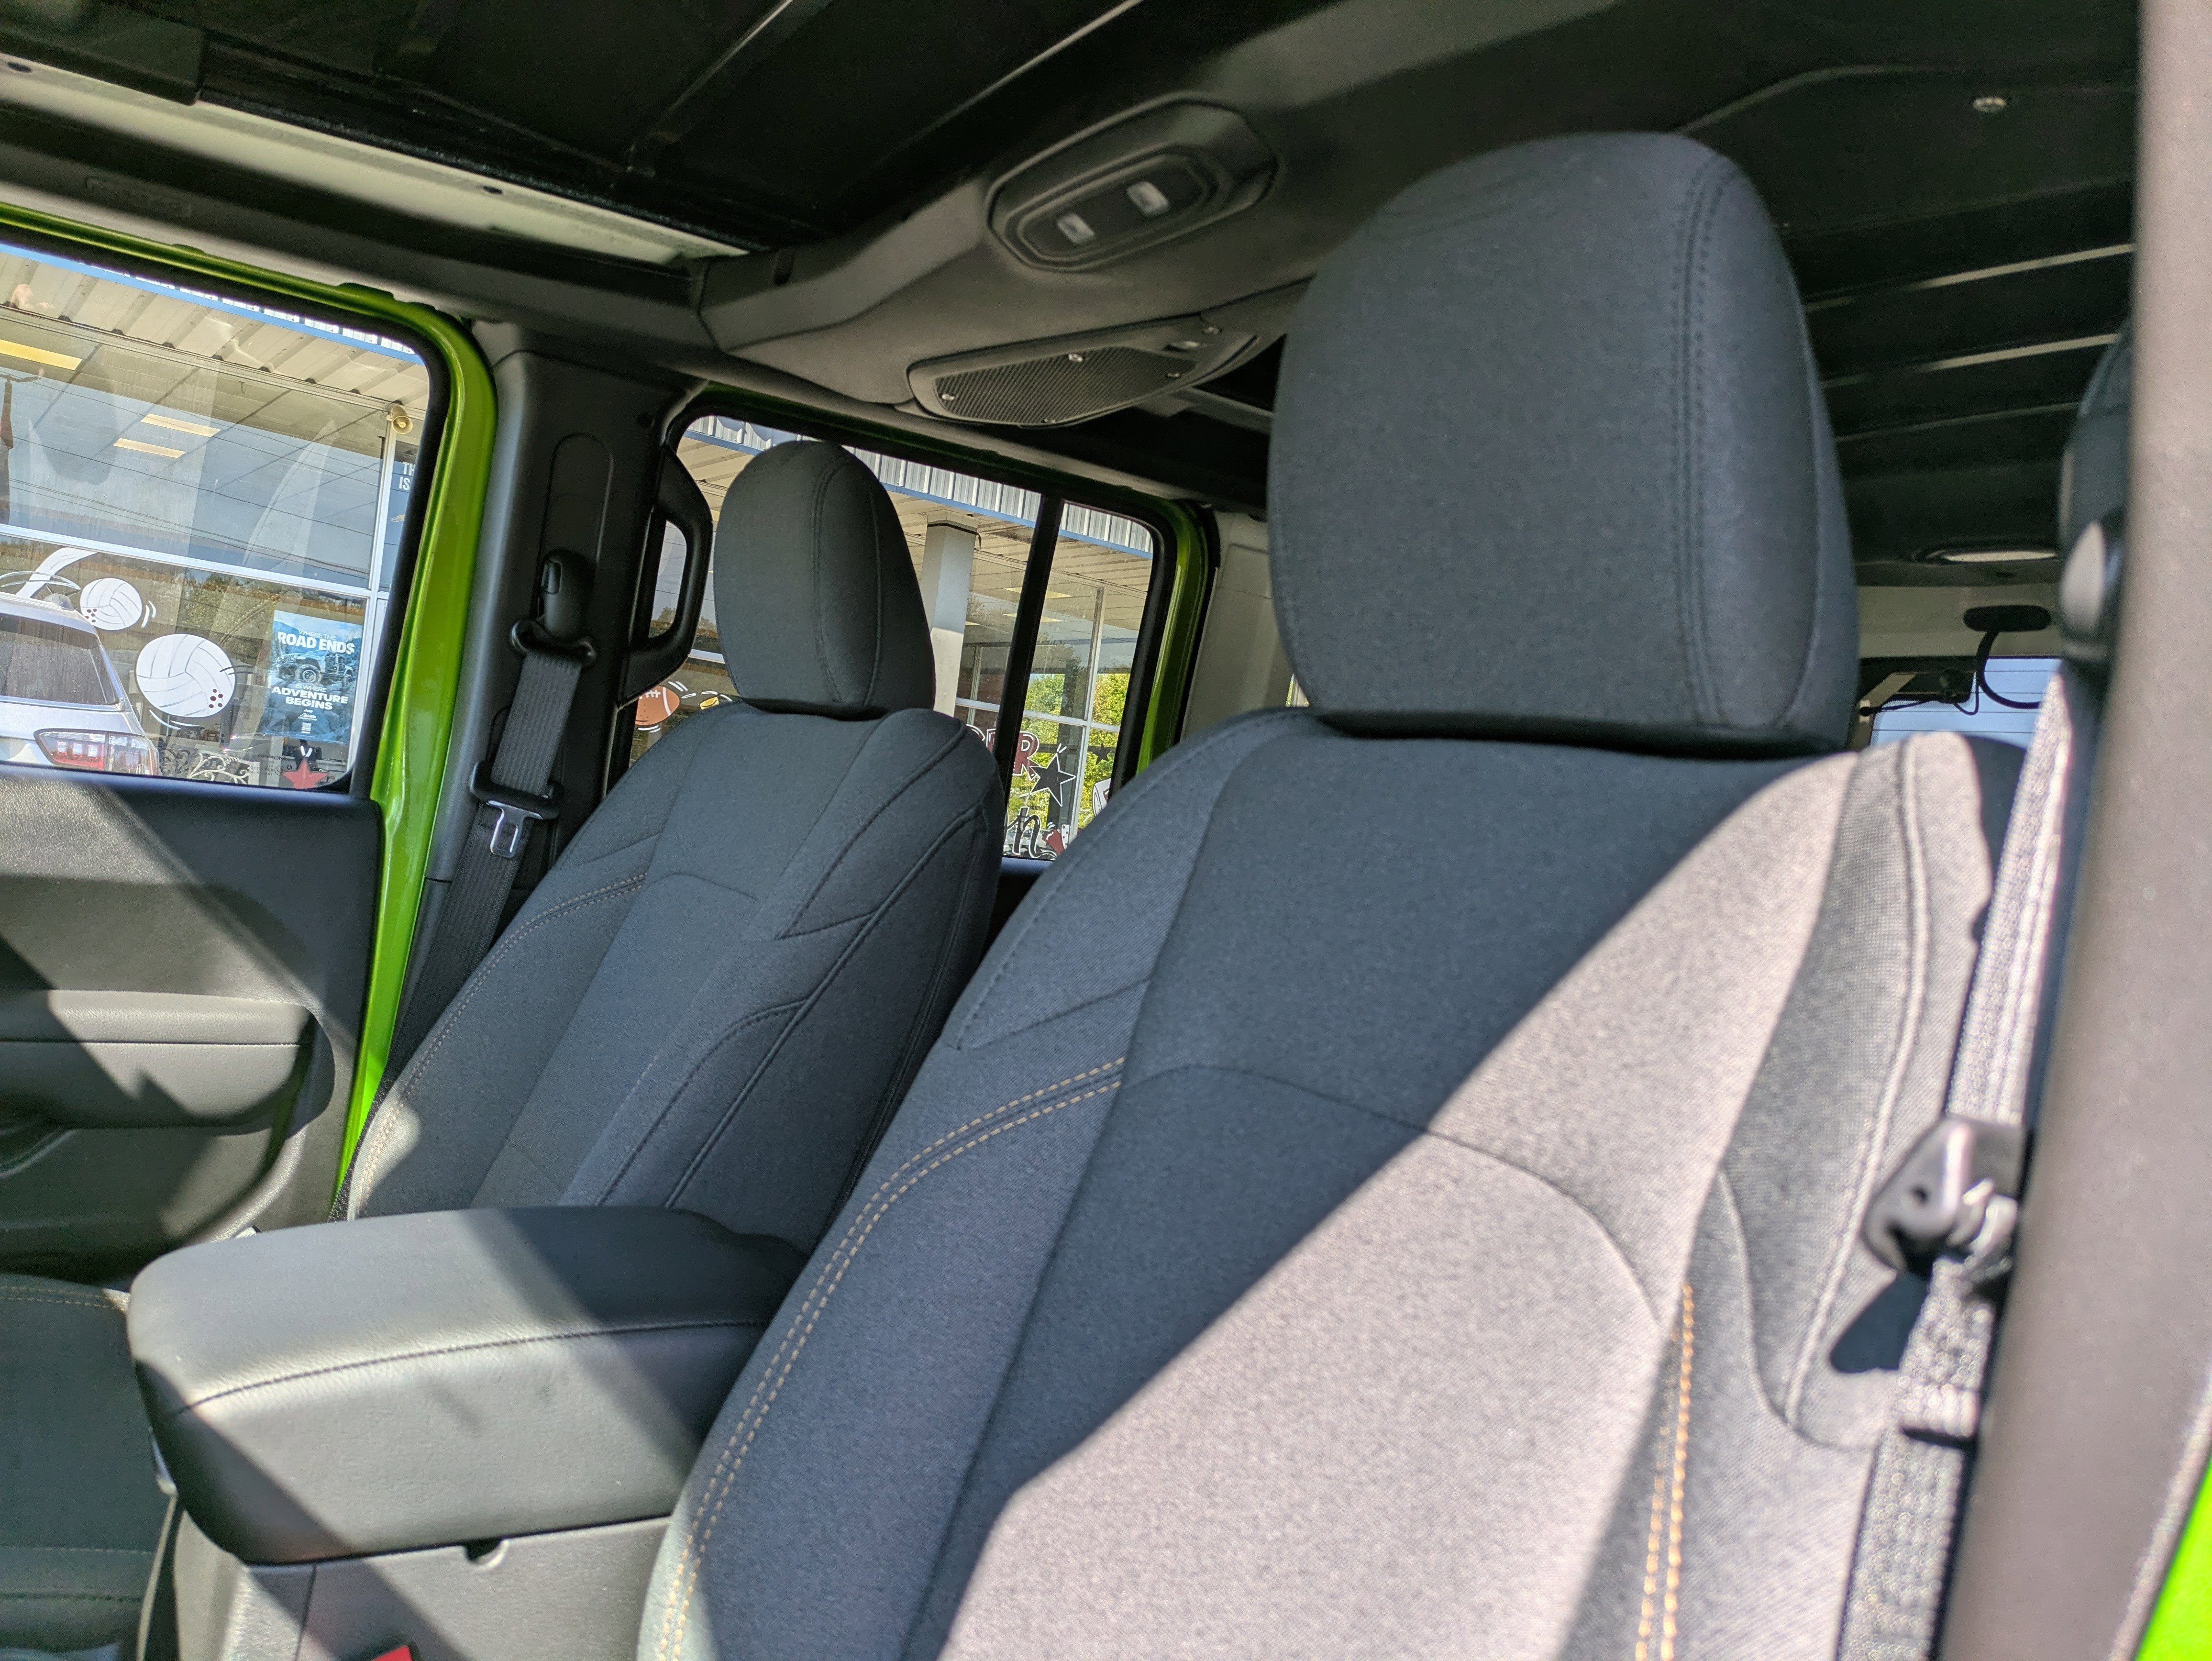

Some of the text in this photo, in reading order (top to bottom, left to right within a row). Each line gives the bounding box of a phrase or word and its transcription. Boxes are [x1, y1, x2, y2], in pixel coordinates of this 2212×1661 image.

[299, 630, 323, 638] WHERE
[277, 631, 355, 655] ROAD ENDS
[271, 686, 348, 704] ADVENTURE
[303, 684, 327, 693] WHERE
[285, 697, 333, 710] BEGINS
